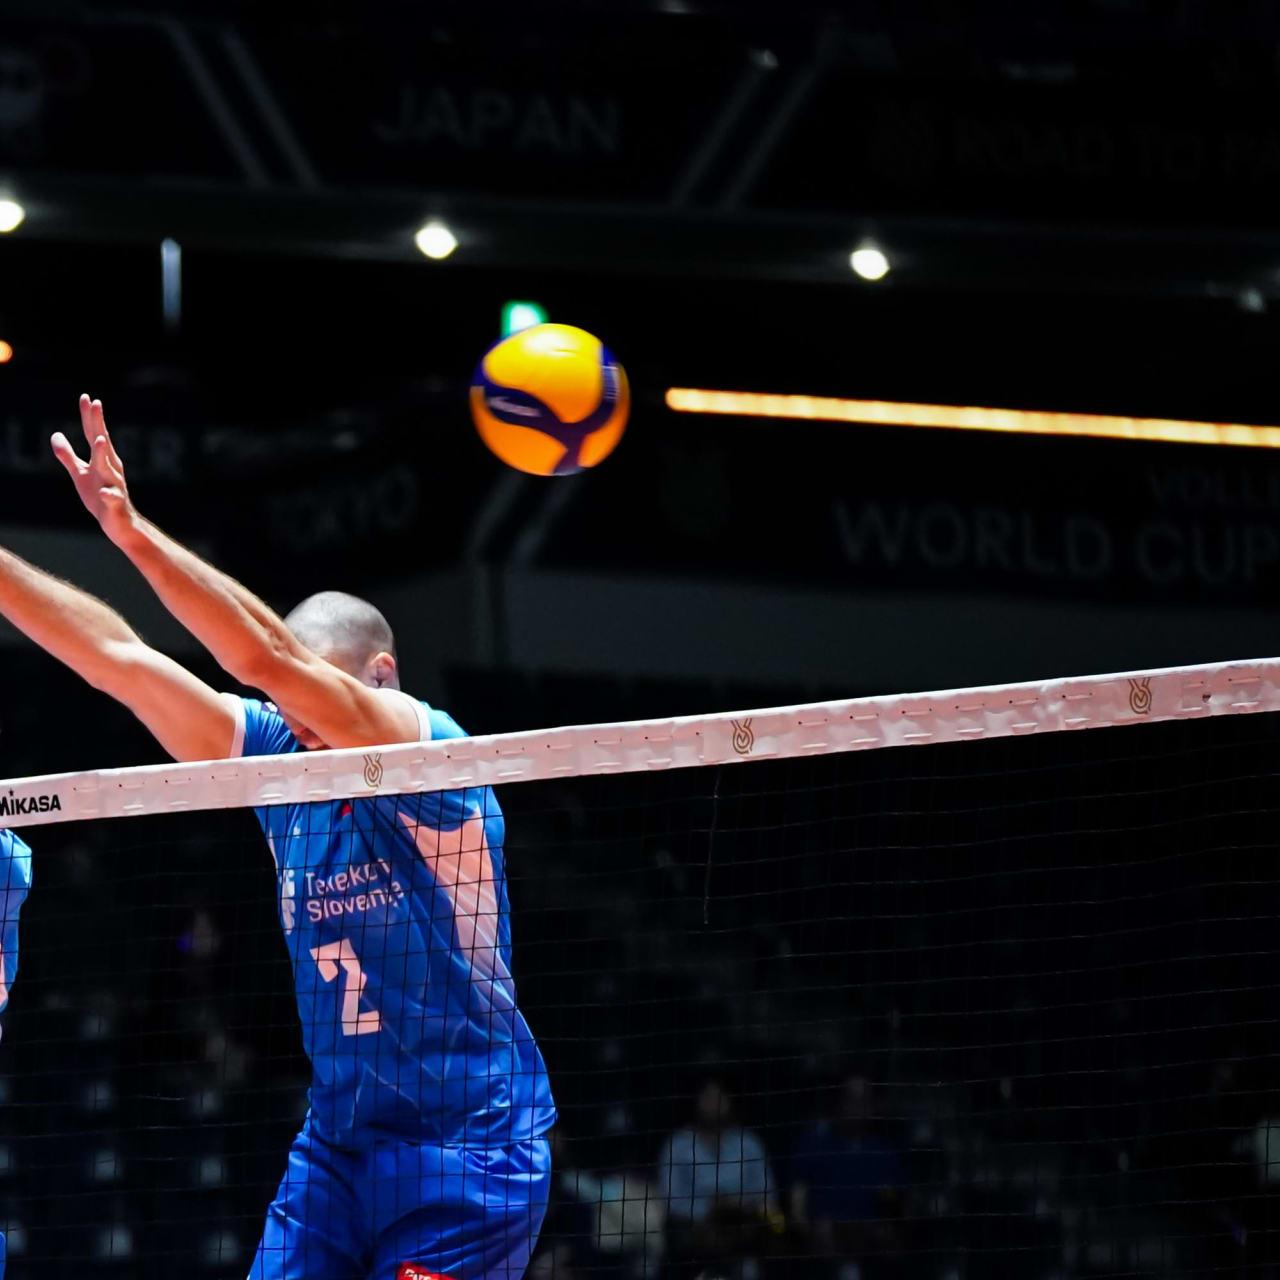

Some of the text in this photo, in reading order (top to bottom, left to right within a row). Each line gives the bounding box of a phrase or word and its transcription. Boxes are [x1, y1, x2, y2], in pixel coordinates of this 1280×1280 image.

[369, 80, 626, 156] JAPAN
[834, 498, 1117, 582] WORLD
[309, 938, 382, 1037] 2
